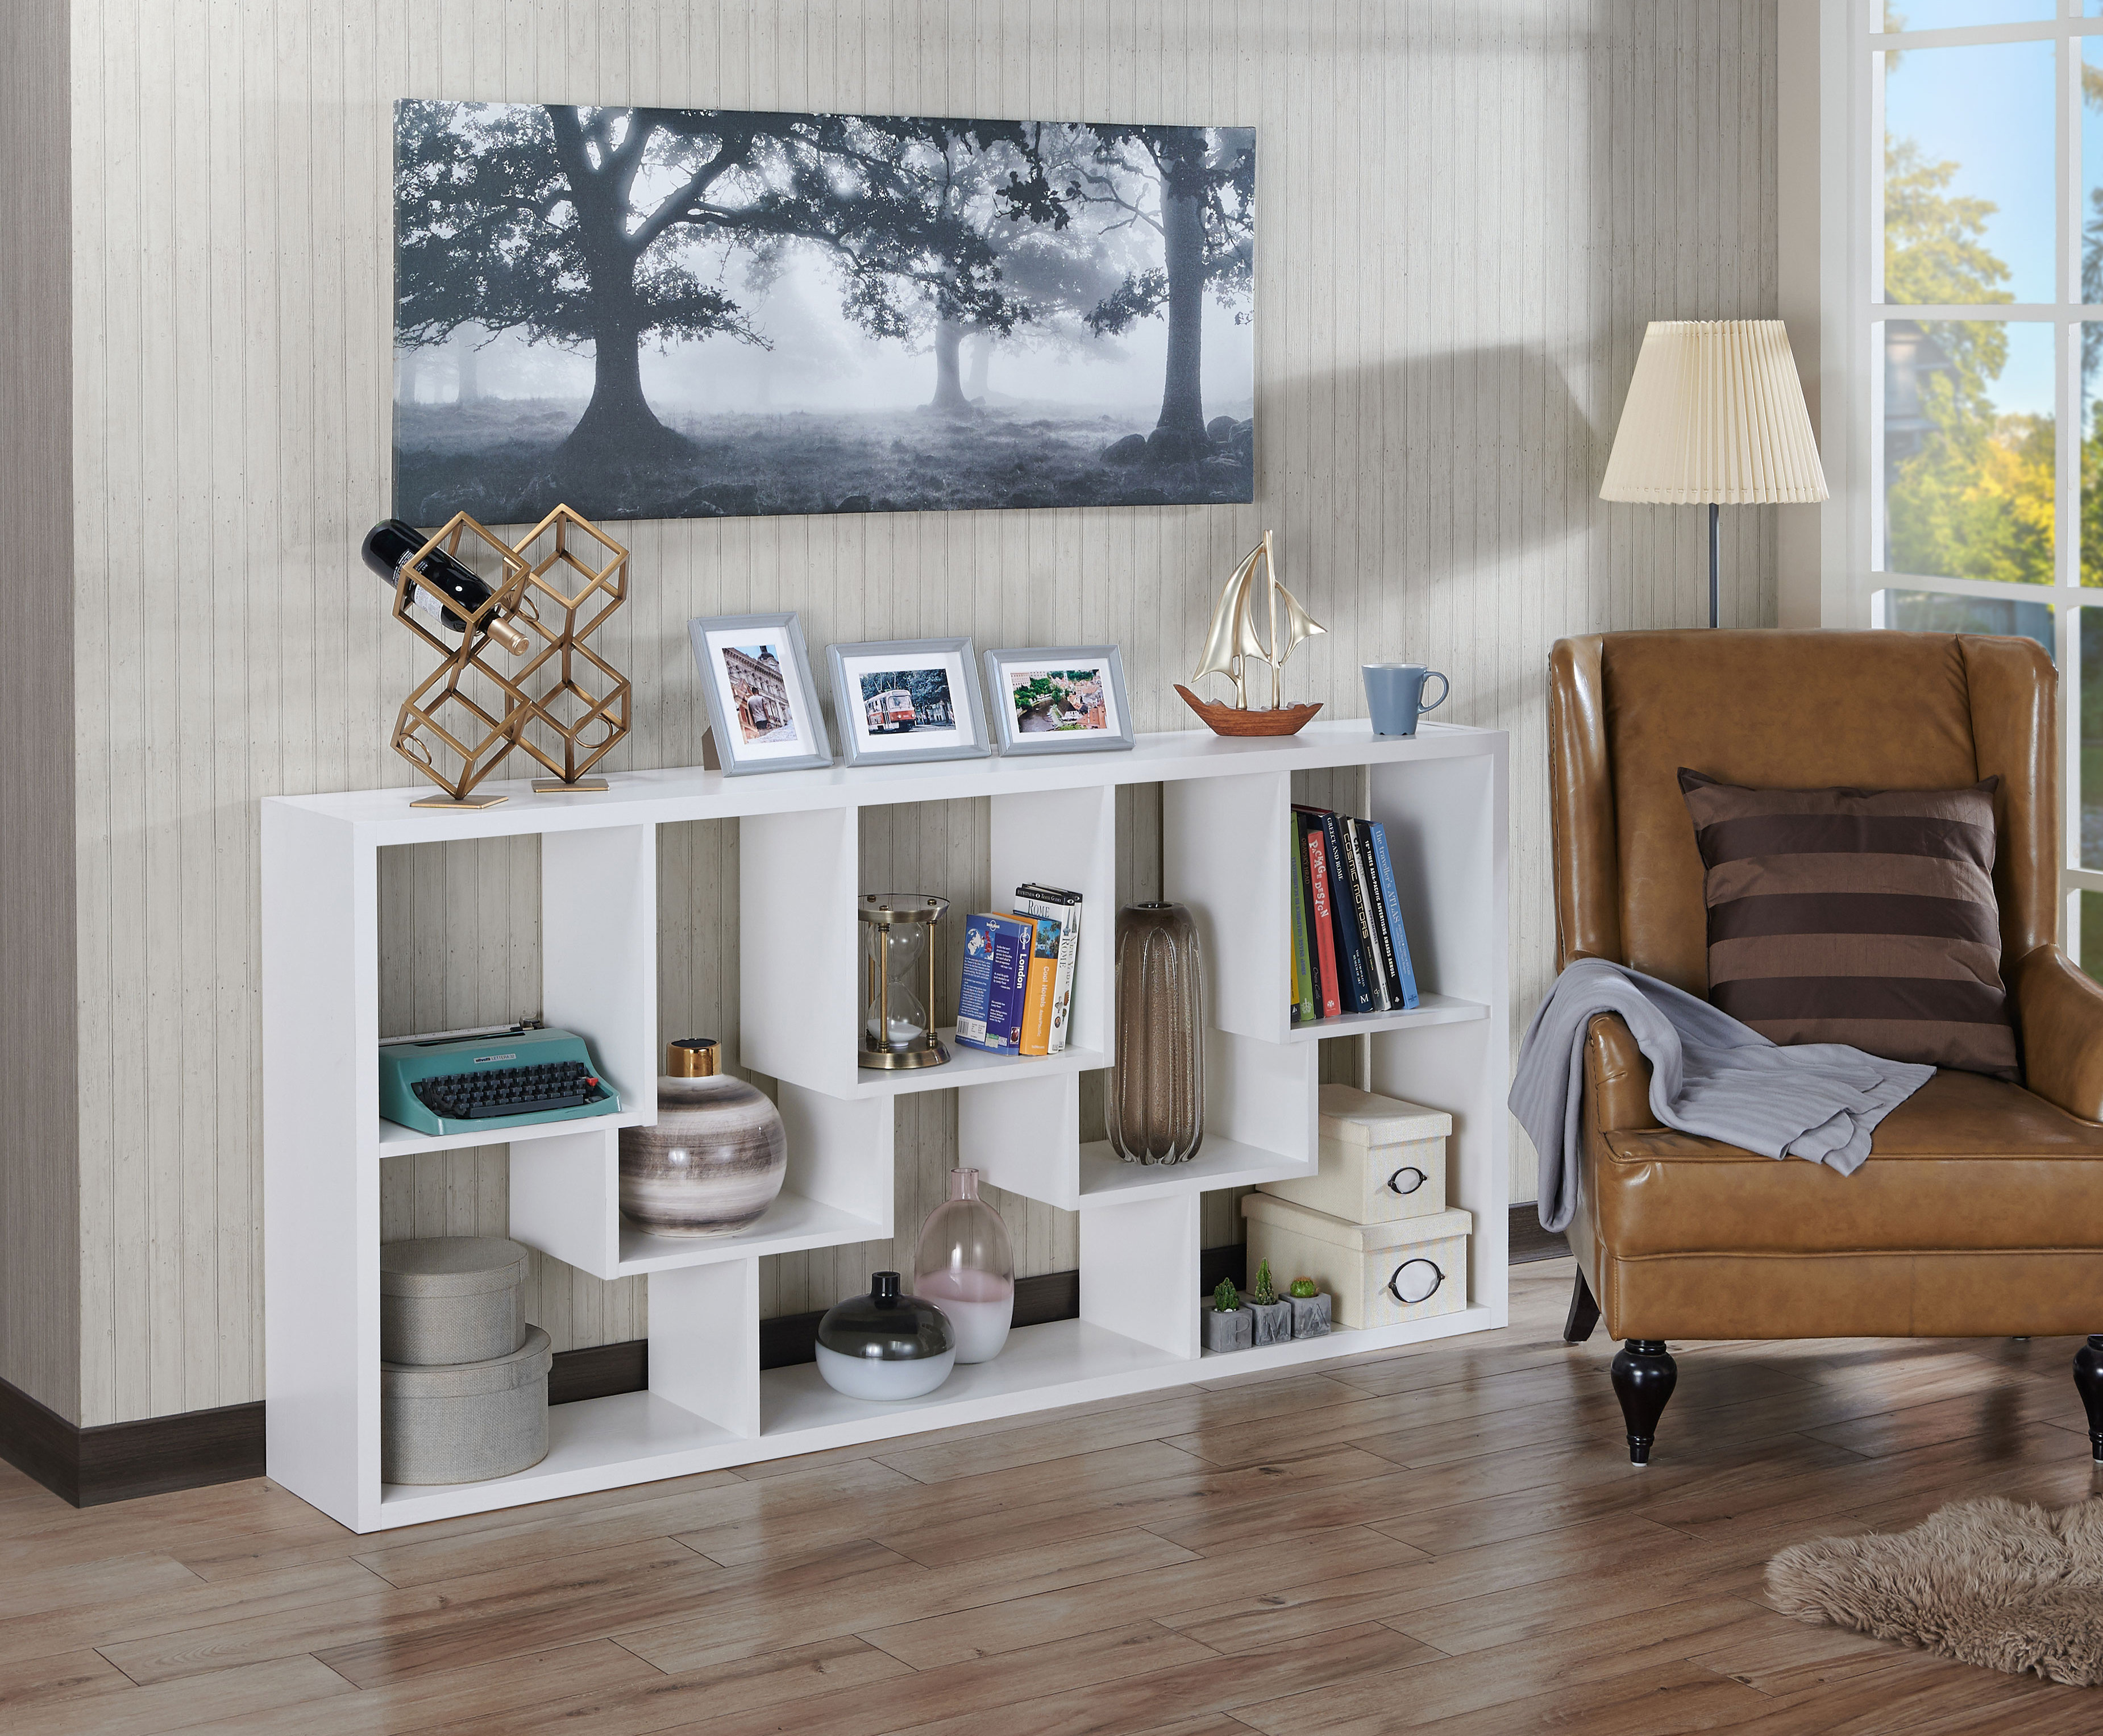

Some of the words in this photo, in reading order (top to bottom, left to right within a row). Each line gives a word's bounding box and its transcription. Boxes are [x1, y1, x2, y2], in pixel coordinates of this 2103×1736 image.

[1327, 817, 1337, 845] GREECE
[1309, 839, 1326, 879] PACKAGE
[1315, 882, 1329, 918] DESIGN
[1344, 833, 1358, 882] COSMIC
[1353, 883, 1369, 939] MOTORS
[1370, 867, 1381, 902] ASIA-PACIFIC
[1377, 902, 1387, 935] ADVERTISING
[1379, 846, 1393, 888] traveller's
[1387, 890, 1400, 923] ATLAS
[1028, 900, 1050, 918] ROME
[1368, 909, 1378, 944] SUPERMODELS
[1059, 938, 1070, 968] ROME
[1016, 953, 1027, 989] London
[1360, 994, 1369, 1004] M
[1227, 1316, 1250, 1345] P
